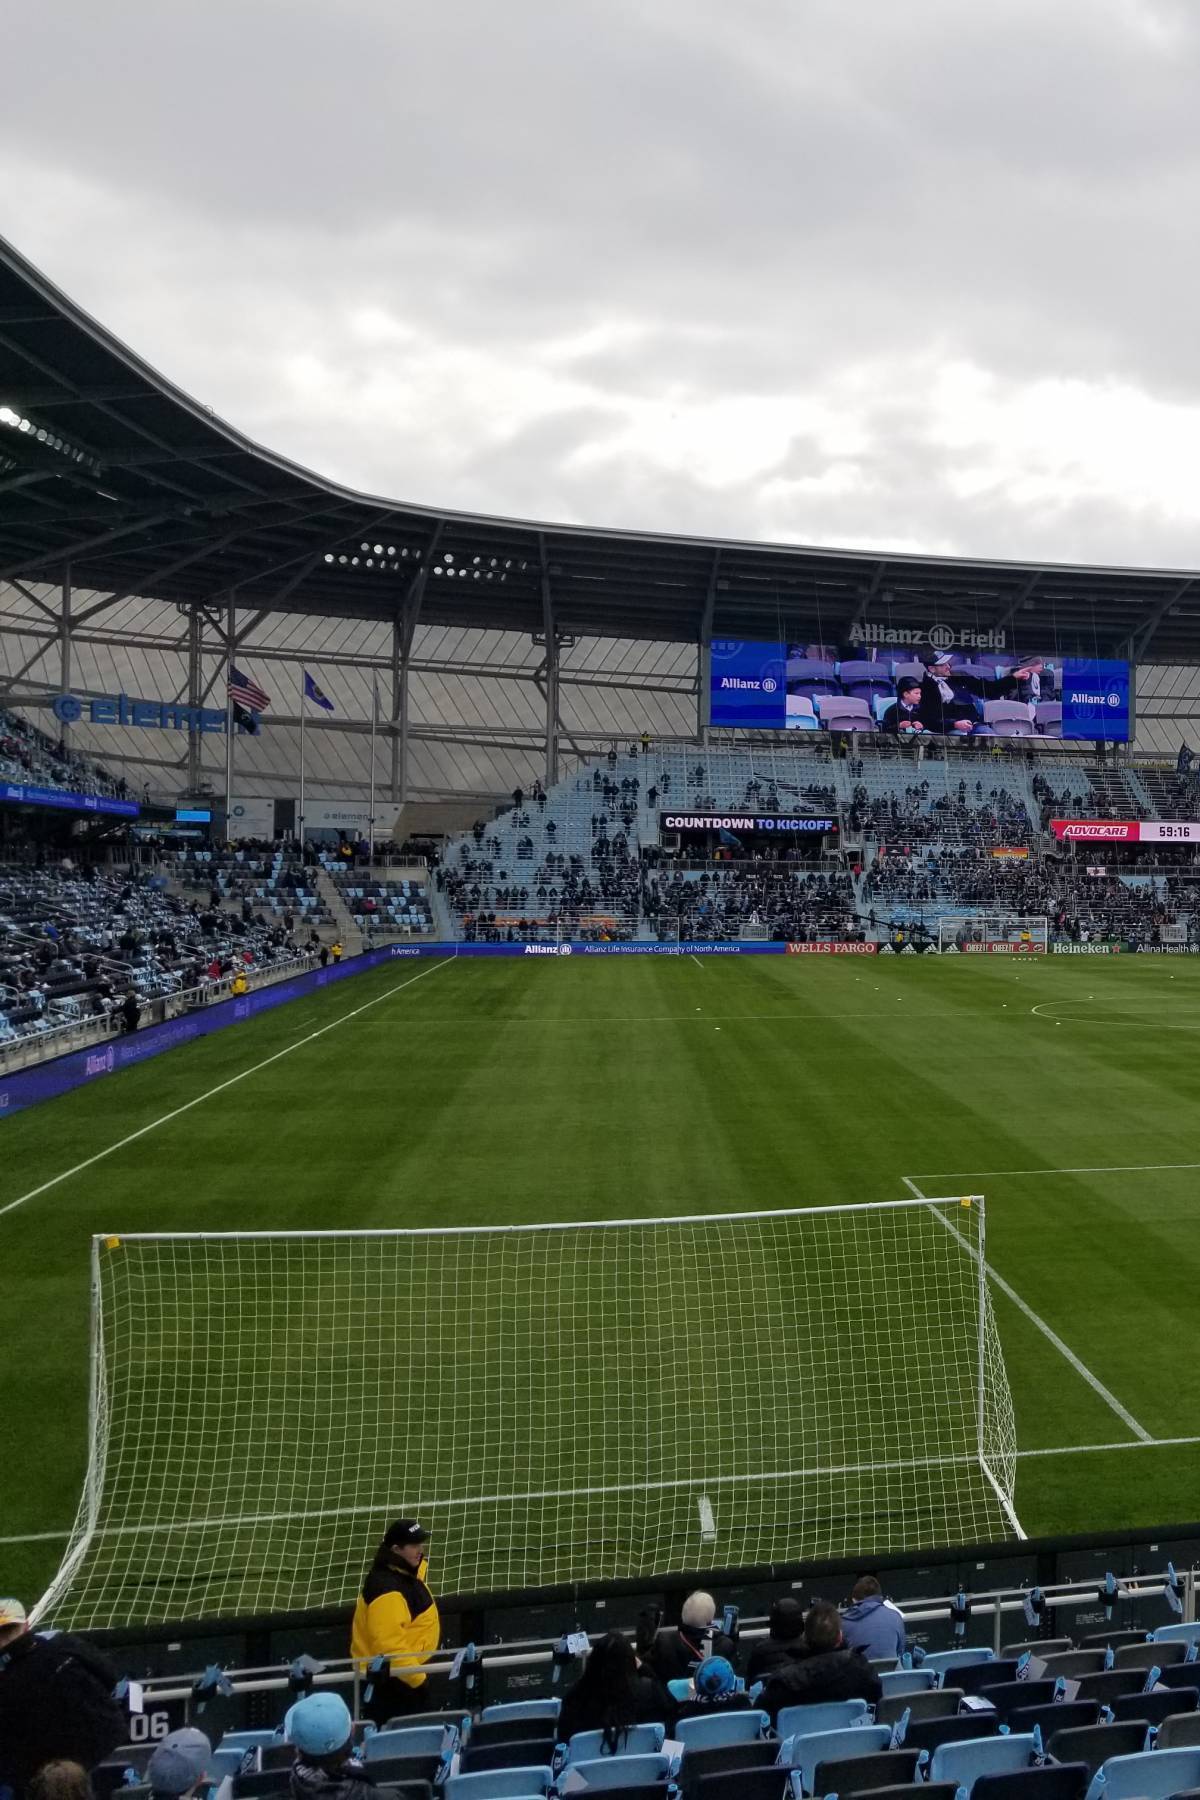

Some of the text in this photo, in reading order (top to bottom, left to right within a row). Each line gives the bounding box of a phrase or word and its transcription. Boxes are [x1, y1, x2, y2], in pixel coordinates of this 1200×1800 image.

[849, 623, 1006, 649] Allianz Field
[721, 677, 761, 690] Allianz
[1071, 693, 1106, 704] Allianz
[665, 817, 754, 829] COUNTDOWN
[756, 818, 775, 830] TO
[1063, 825, 1129, 837] ADVOCARE
[1159, 826, 1190, 838] 59:16
[524, 945, 558, 955] Allianz
[585, 945, 740, 955] Allianz Life Insurance Company of North America
[789, 943, 875, 953] WELLS FARGO
[1053, 943, 1110, 954] Heineken
[1162, 943, 1189, 953] Health
[130, 1711, 169, 1742] 06
